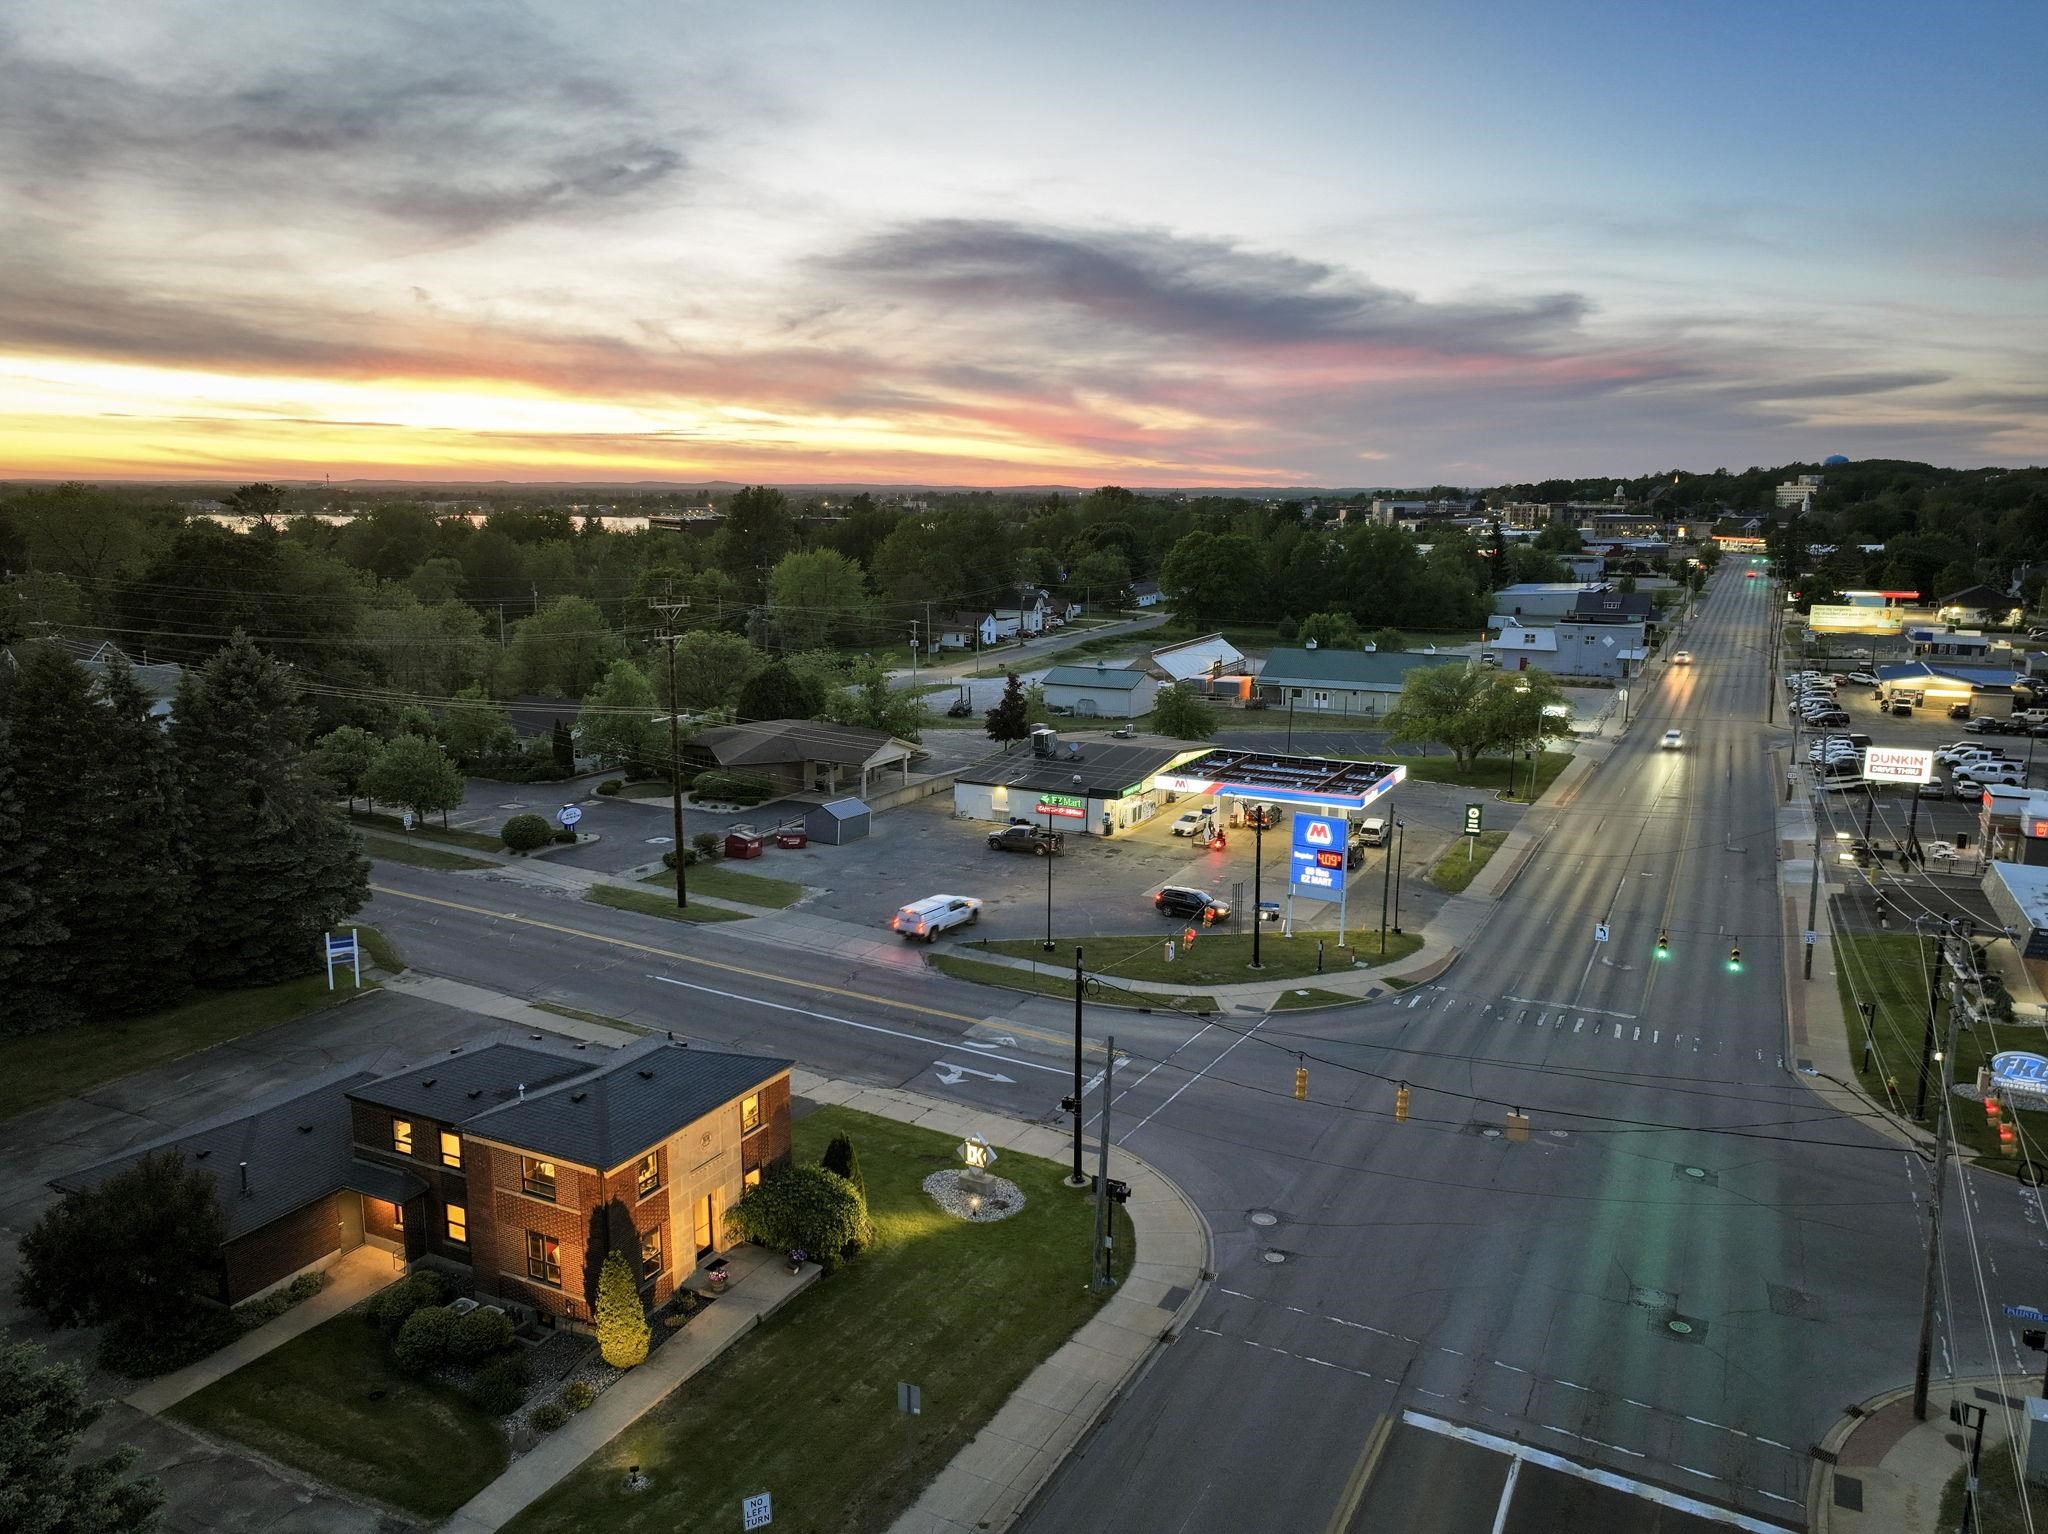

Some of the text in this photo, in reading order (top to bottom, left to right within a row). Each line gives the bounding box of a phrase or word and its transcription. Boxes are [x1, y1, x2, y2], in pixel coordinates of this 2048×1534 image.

[1870, 753, 1927, 766] DUNKIN'
[1871, 765, 1896, 775] DRIVE
[1312, 876, 1333, 887] MART
[750, 1498, 763, 1508] NO
[746, 1505, 768, 1519] LEFT
[745, 1513, 770, 1528] TURN
